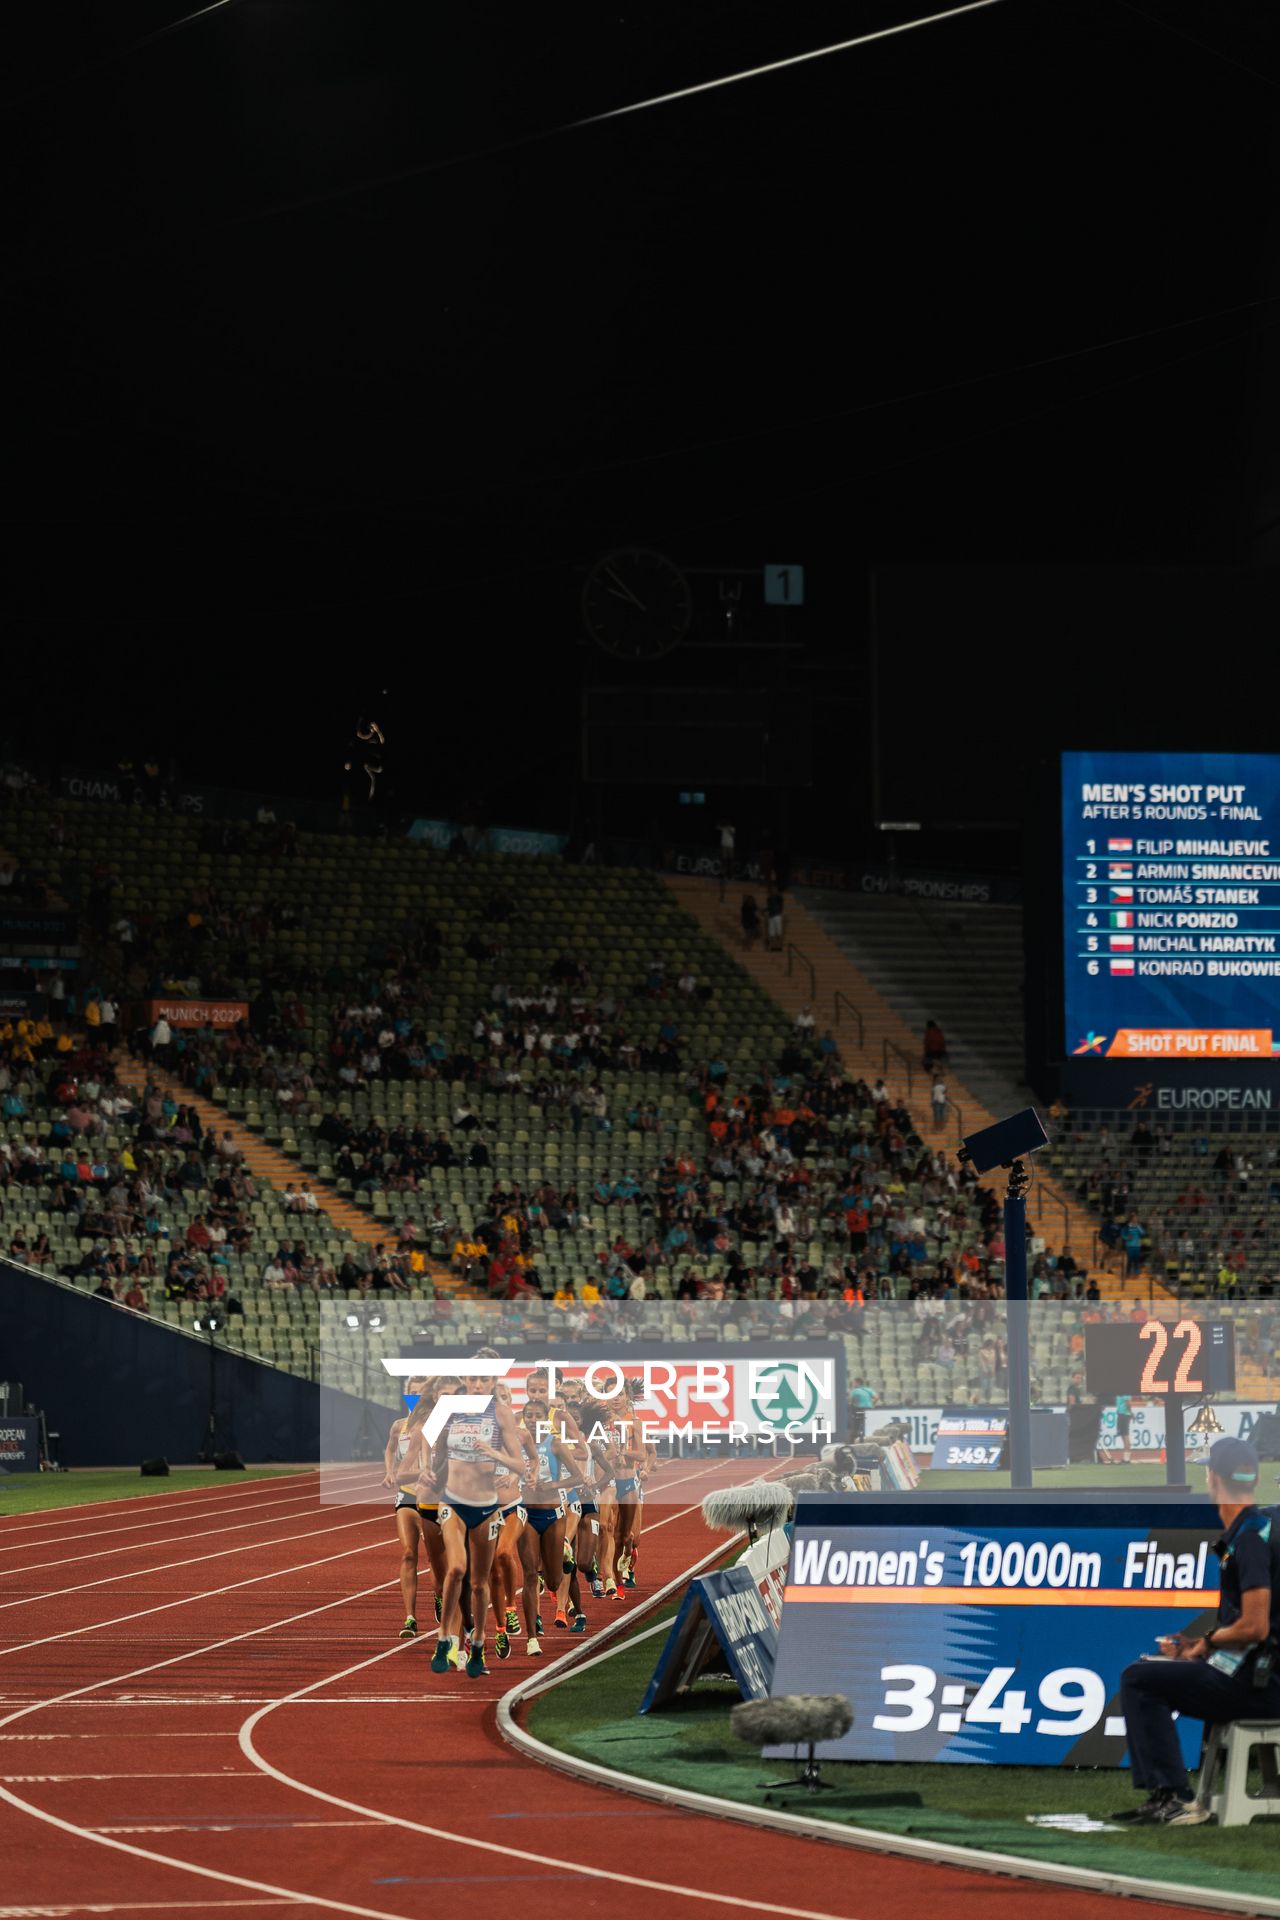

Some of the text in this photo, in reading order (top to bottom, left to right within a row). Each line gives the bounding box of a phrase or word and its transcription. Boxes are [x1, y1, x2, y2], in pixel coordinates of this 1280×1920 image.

[777, 568, 789, 602] 1
[1082, 784, 1246, 804] MEN'S SHOT PUT
[1082, 805, 1130, 820] AFTER
[1132, 806, 1142, 820] 5
[1144, 806, 1208, 821] ROUNDS
[1220, 806, 1262, 821] FINAL
[1086, 840, 1270, 857] 1 FILIP MIHALJEVIC
[1086, 864, 1097, 879] 2
[1137, 864, 1189, 879] ARMIN
[1087, 884, 1259, 905] 3 TOMÁŠ STANEK
[1087, 912, 1238, 928] 4 NICK PONZIO
[1087, 936, 1276, 953] 5 MICHAL HARATYK
[1087, 960, 1100, 976] 6
[1139, 961, 1205, 977] KONRAD
[160, 1006, 242, 1023] MUNICH 2022
[1127, 1034, 1260, 1053] SHOT PUT FINAL
[1157, 1089, 1272, 1110] EUROPEAN
[1139, 1319, 1203, 1393] 22
[1132, 1429, 1151, 1447] 30
[1155, 1432, 1198, 1448] yrs
[946, 1446, 1001, 1464] 3:49.7
[793, 1539, 1209, 1590] Women's 10000m Final
[872, 1663, 1180, 1737] 3:49.
